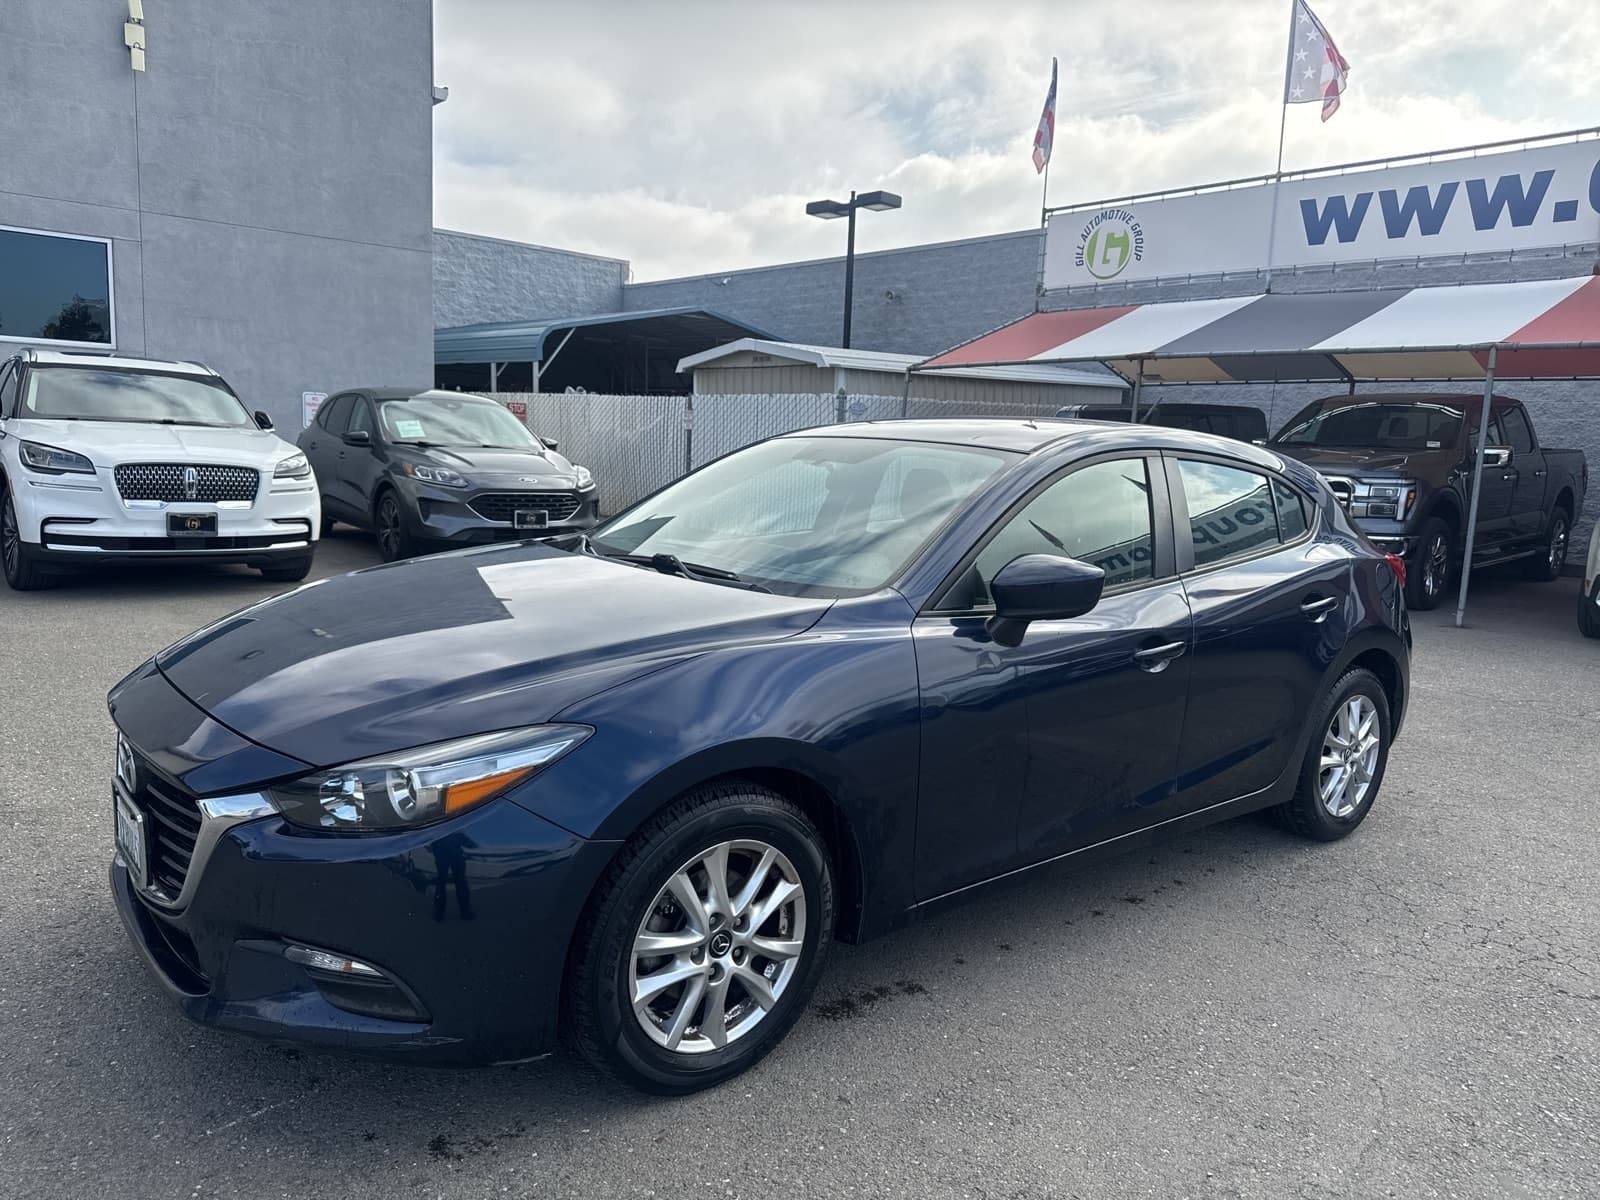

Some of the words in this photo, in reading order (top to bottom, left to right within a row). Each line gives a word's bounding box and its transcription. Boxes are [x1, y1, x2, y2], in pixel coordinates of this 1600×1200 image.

[1075, 244, 1085, 267] GILL
[1081, 209, 1135, 243] AUTOMOTIVE
[1130, 223, 1144, 261] GROUP
[508, 403, 526, 413] STOP
